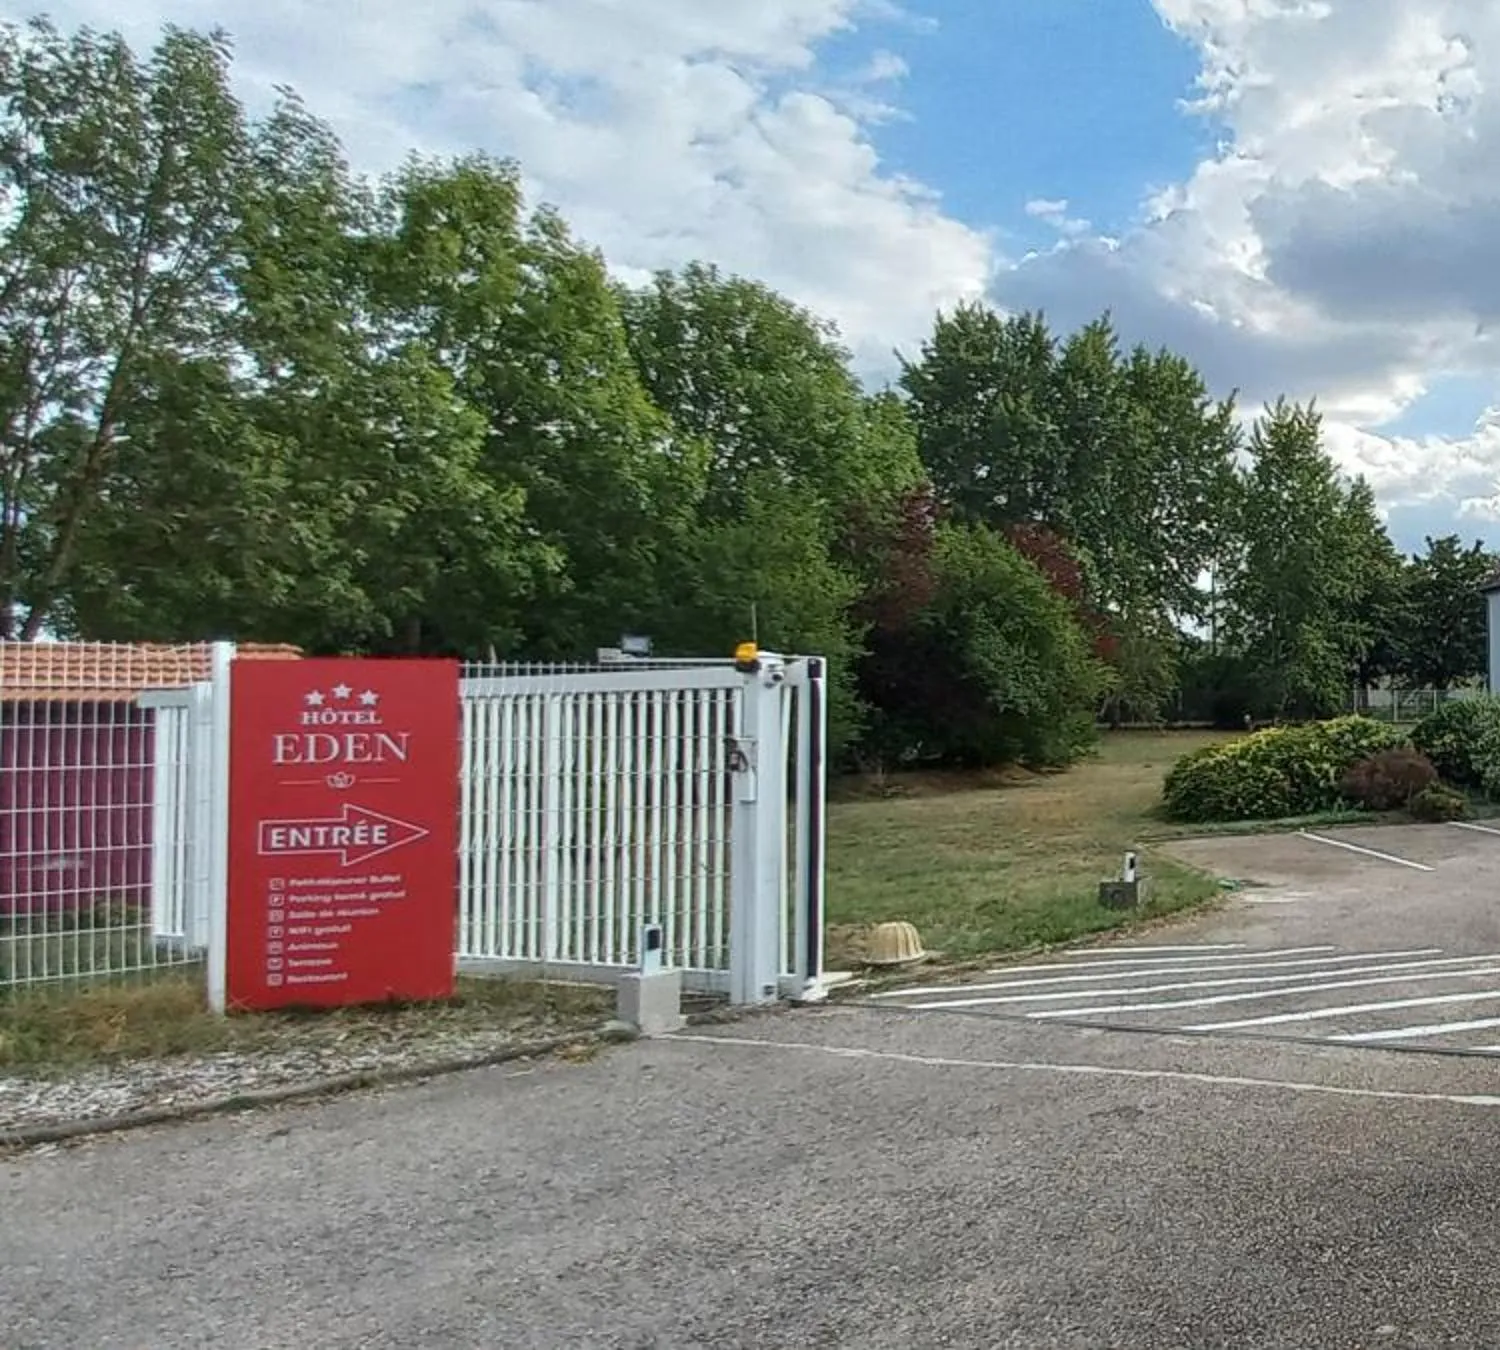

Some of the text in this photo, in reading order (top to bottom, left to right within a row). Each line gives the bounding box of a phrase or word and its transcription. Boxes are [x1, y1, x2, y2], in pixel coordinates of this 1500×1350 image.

[301, 708, 382, 725] HÔTEL
[272, 732, 411, 763] EDEN
[271, 819, 388, 848] ENTRÉE
